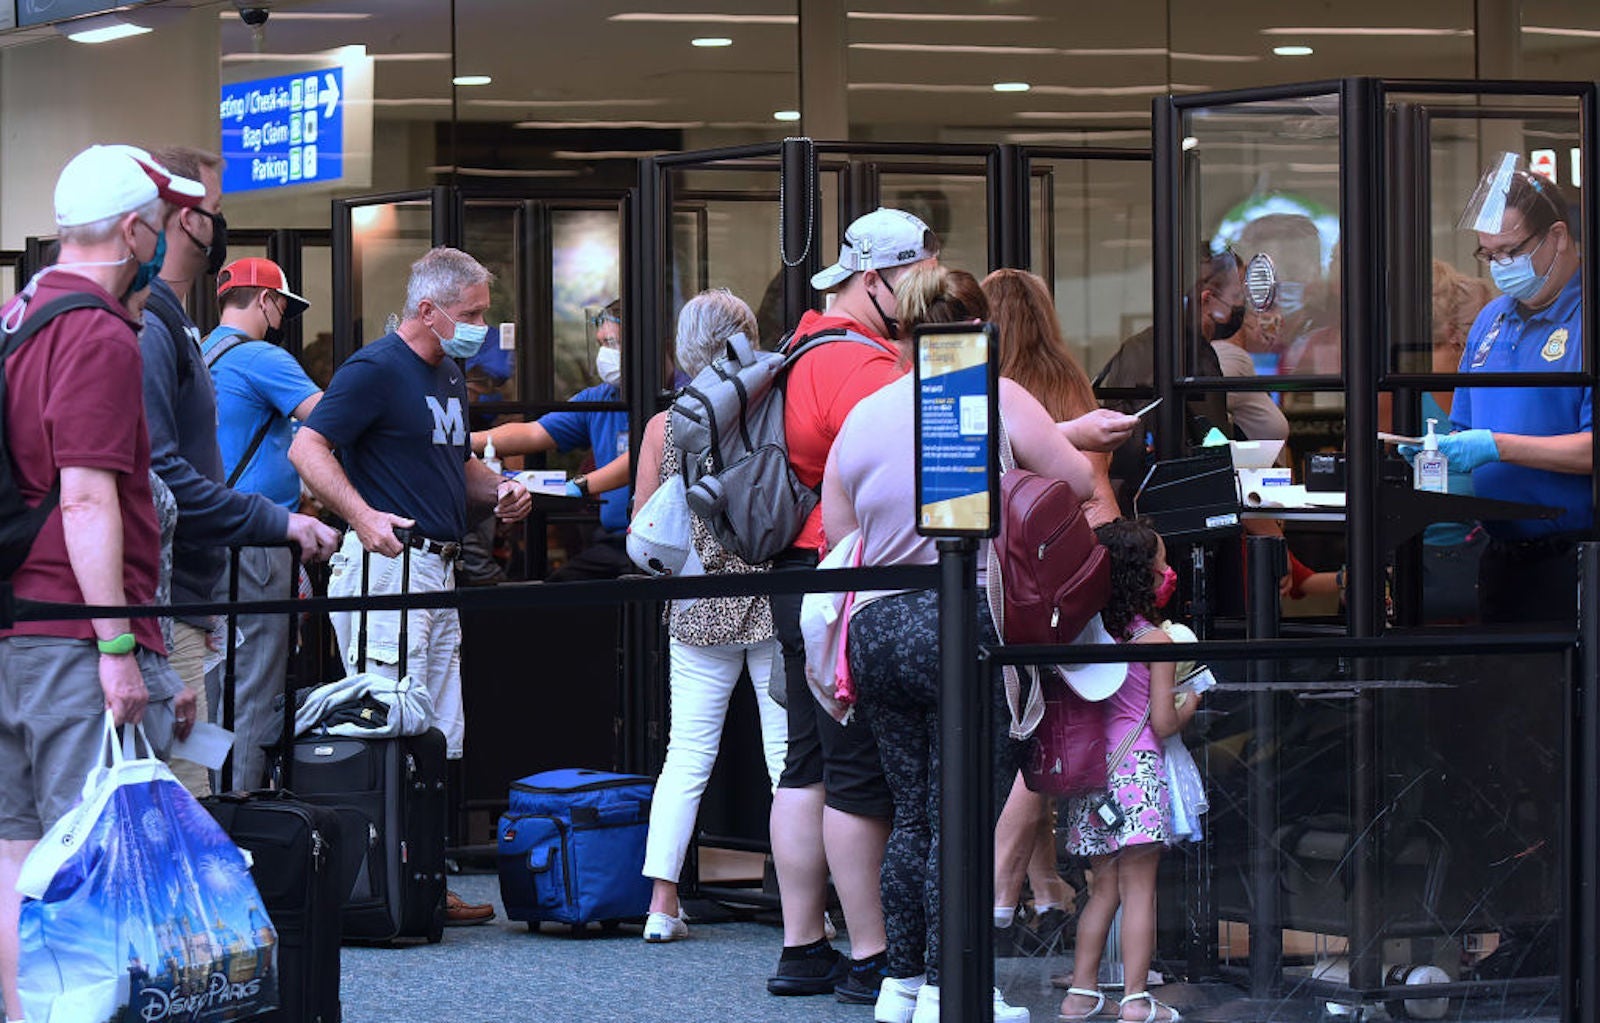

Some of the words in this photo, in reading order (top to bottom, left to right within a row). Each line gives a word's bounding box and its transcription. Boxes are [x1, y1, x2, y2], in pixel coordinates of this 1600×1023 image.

[250, 86, 290, 115] Check-in
[243, 125, 261, 152] Bag
[263, 121, 288, 146] Claim
[252, 156, 288, 184] Parking
[425, 396, 466, 447] M
